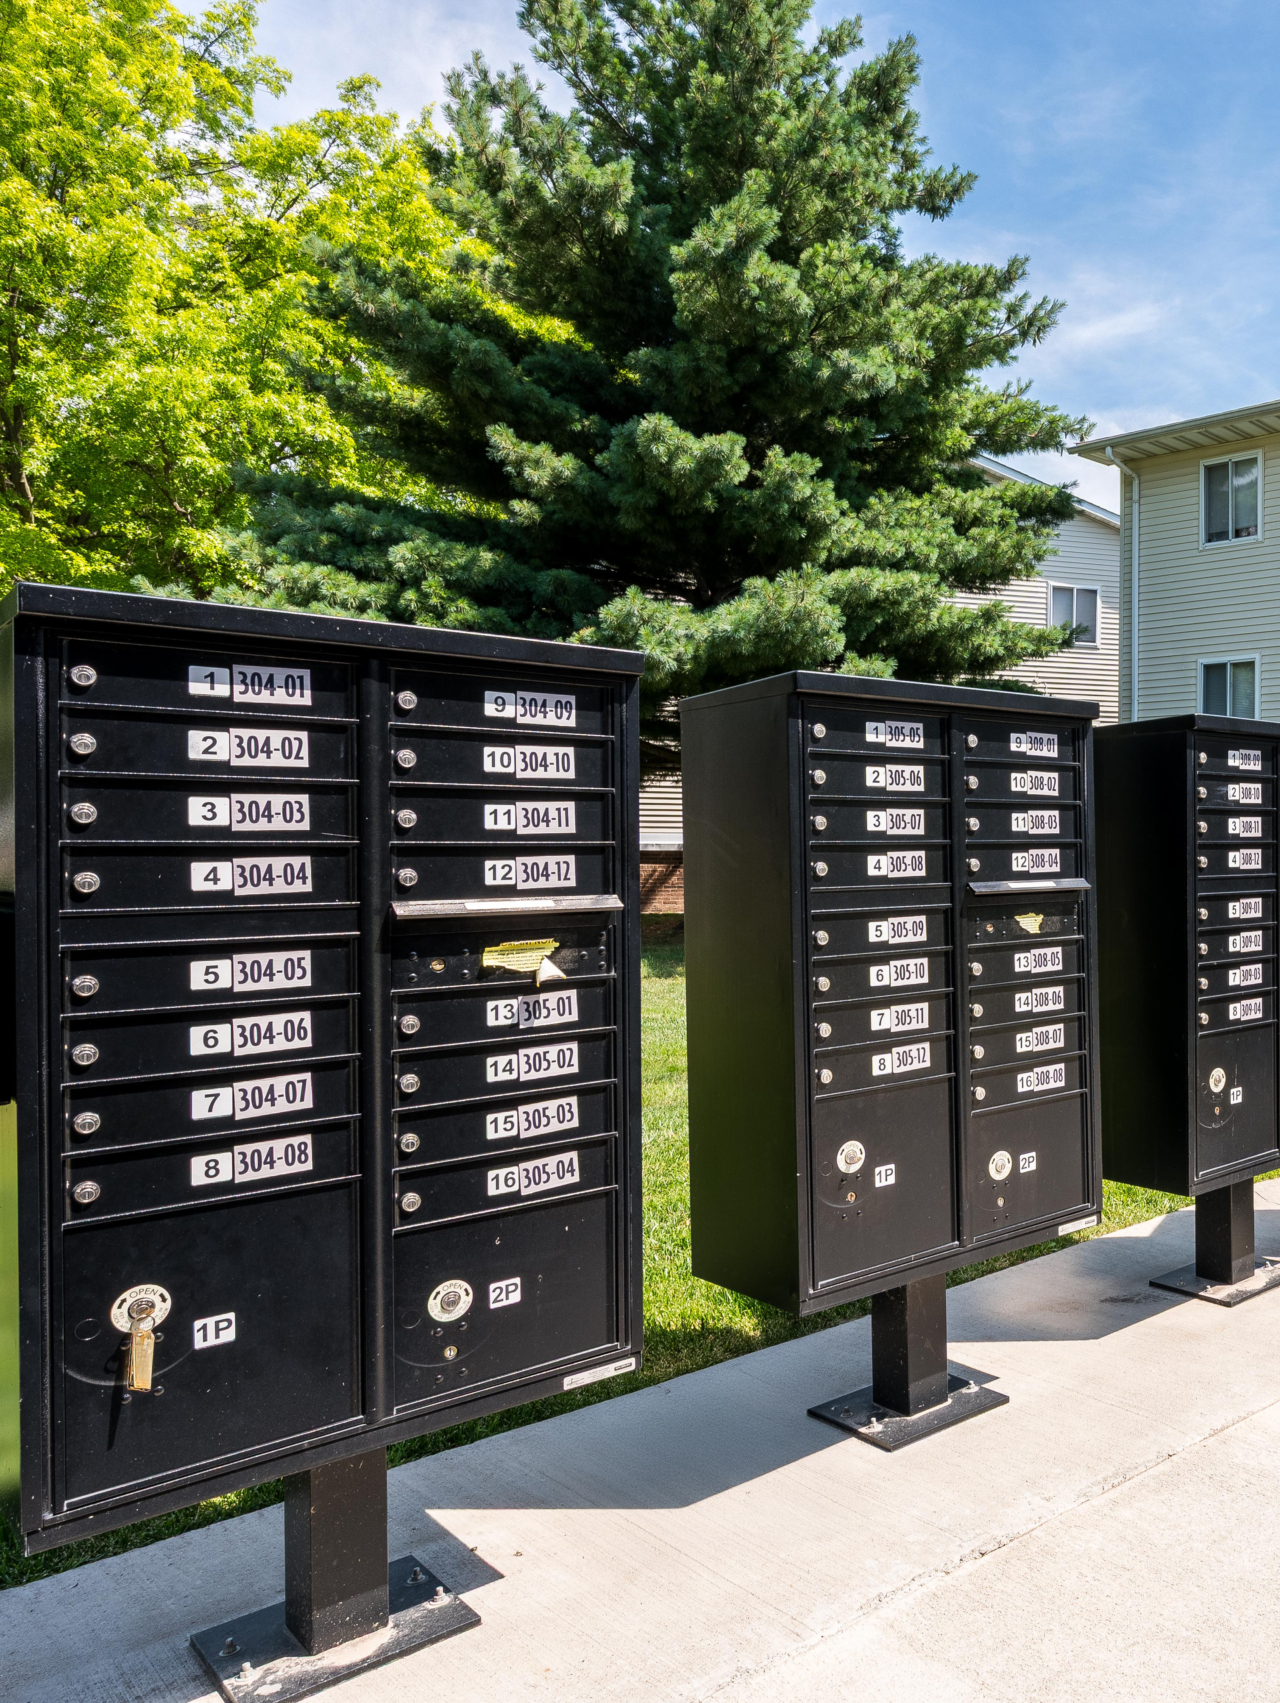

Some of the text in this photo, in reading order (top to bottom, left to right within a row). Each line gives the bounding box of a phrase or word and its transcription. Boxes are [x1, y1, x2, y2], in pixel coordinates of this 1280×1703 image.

[203, 671, 305, 698] 1 304-01
[494, 695, 573, 721] 9 304-09
[872, 725, 921, 744] 1 305-05
[201, 734, 304, 761] 2 304-02
[487, 750, 571, 773] 10 304-10
[872, 769, 922, 787] 2 305-06
[1012, 774, 1057, 792] 10 308-02
[1231, 786, 1237, 798] 2
[201, 799, 306, 825] 3 304-03
[489, 806, 570, 829] 11 304-11
[872, 813, 922, 831] 3 305-07
[1014, 814, 1058, 830] 11 308-03
[1231, 820, 1237, 832] 3
[203, 861, 309, 889] 4 304-04
[488, 860, 571, 884] 12 304-12
[873, 855, 924, 873] 4 305-08
[874, 920, 924, 939] 5 305-09
[203, 956, 307, 985] 5 304-05
[1016, 950, 1061, 969] 13 308-05
[490, 995, 573, 1022] 13 305-01
[1016, 990, 1062, 1009] 14 308-06
[876, 1007, 924, 1027] 7 305-11
[1232, 1005, 1238, 1017] 8
[202, 1017, 308, 1049] 6 304-06
[1017, 1027, 1062, 1049] 15 308-07
[489, 1047, 575, 1078] 14 305-02
[878, 1046, 927, 1072] 8 305-12
[1019, 1067, 1064, 1089] 16 308-08
[204, 1078, 308, 1113] 7 304-07
[1231, 1089, 1241, 1101] 1P
[489, 1102, 575, 1134] 15 305-03
[204, 1141, 309, 1179] 8 304-08
[1020, 1155, 1035, 1170] 2P
[490, 1157, 576, 1191] 16 305-04
[876, 1168, 894, 1183] 1P
[128, 1287, 159, 1299] OPEN
[441, 1282, 464, 1292] OPEN
[491, 1282, 519, 1305] 2P
[196, 1318, 233, 1343] 1P
